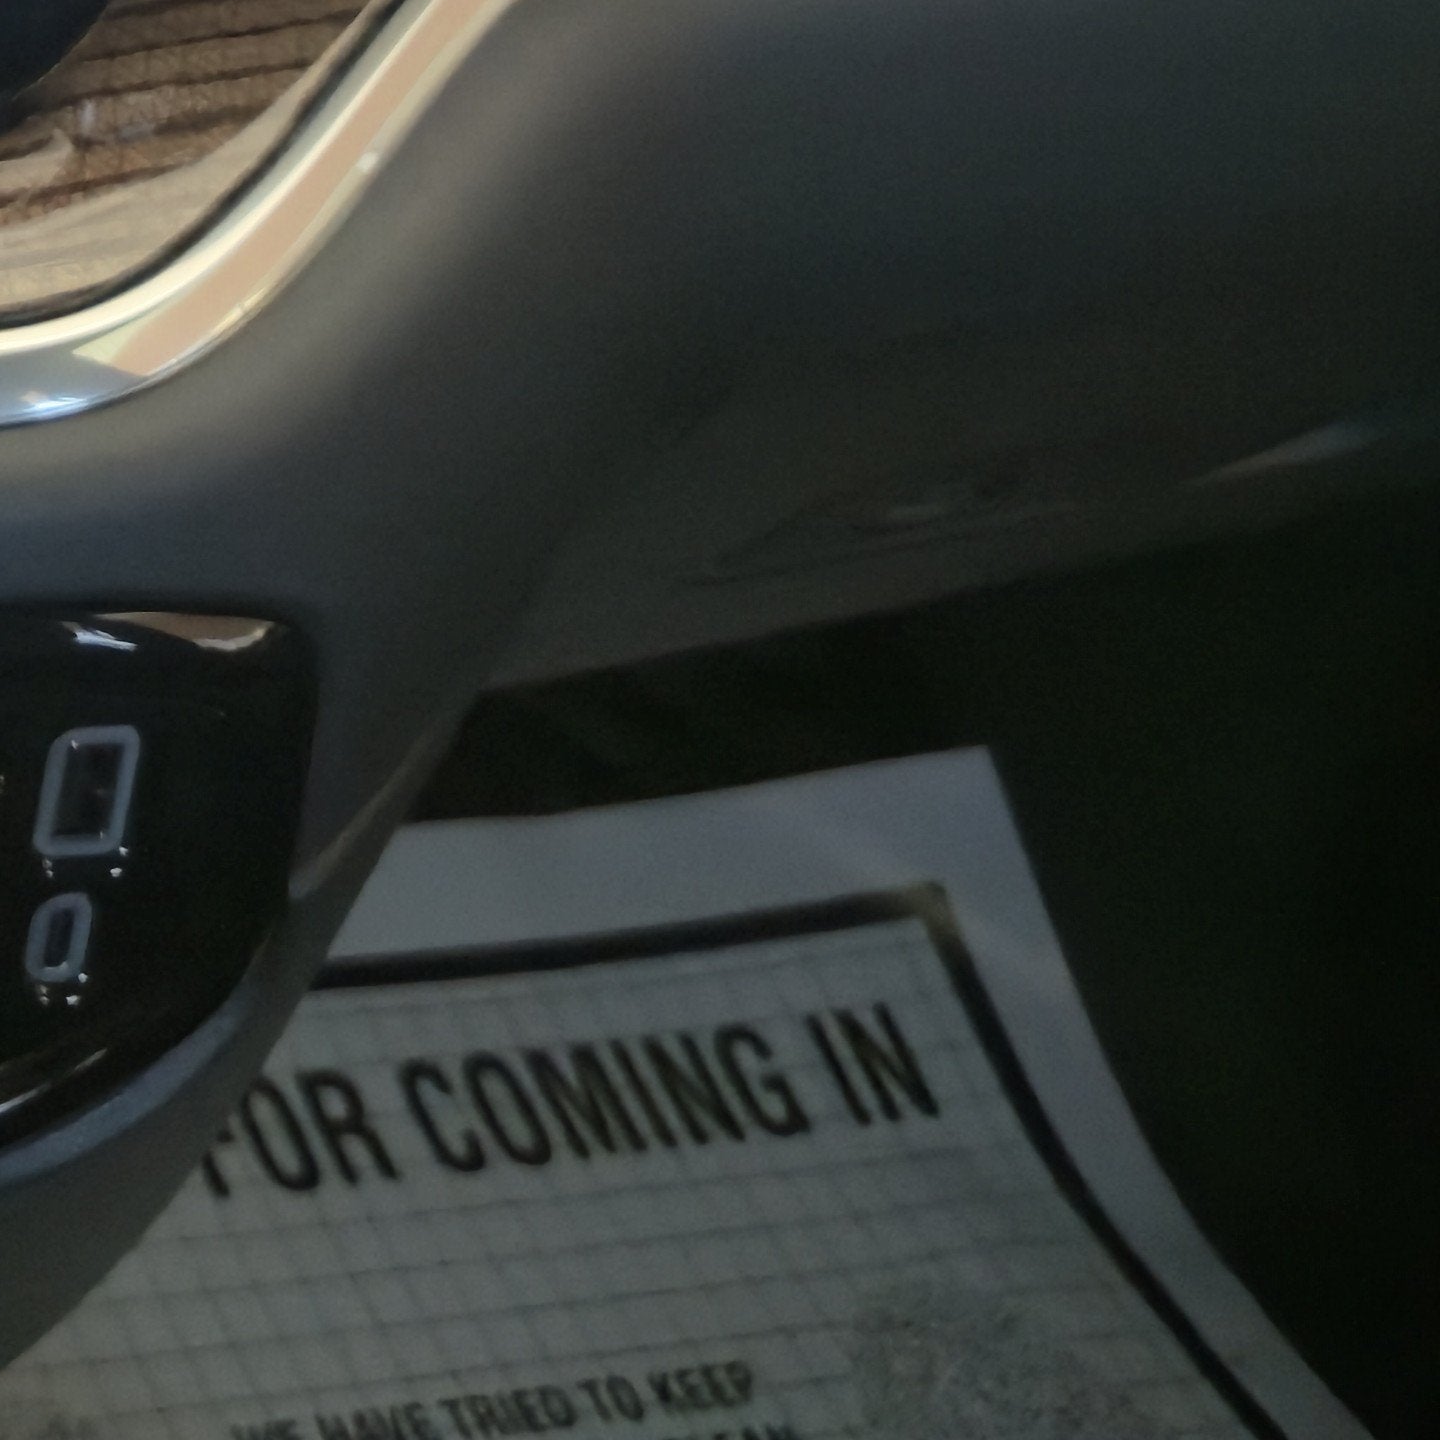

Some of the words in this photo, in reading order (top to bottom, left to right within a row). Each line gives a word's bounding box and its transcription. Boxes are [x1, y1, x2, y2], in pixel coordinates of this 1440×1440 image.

[395, 1022, 812, 1173] COMING
[807, 1001, 940, 1123] IN
[437, 1385, 579, 1439] TRIED
[575, 1374, 646, 1422] TO
[648, 1359, 754, 1412] KEEP
